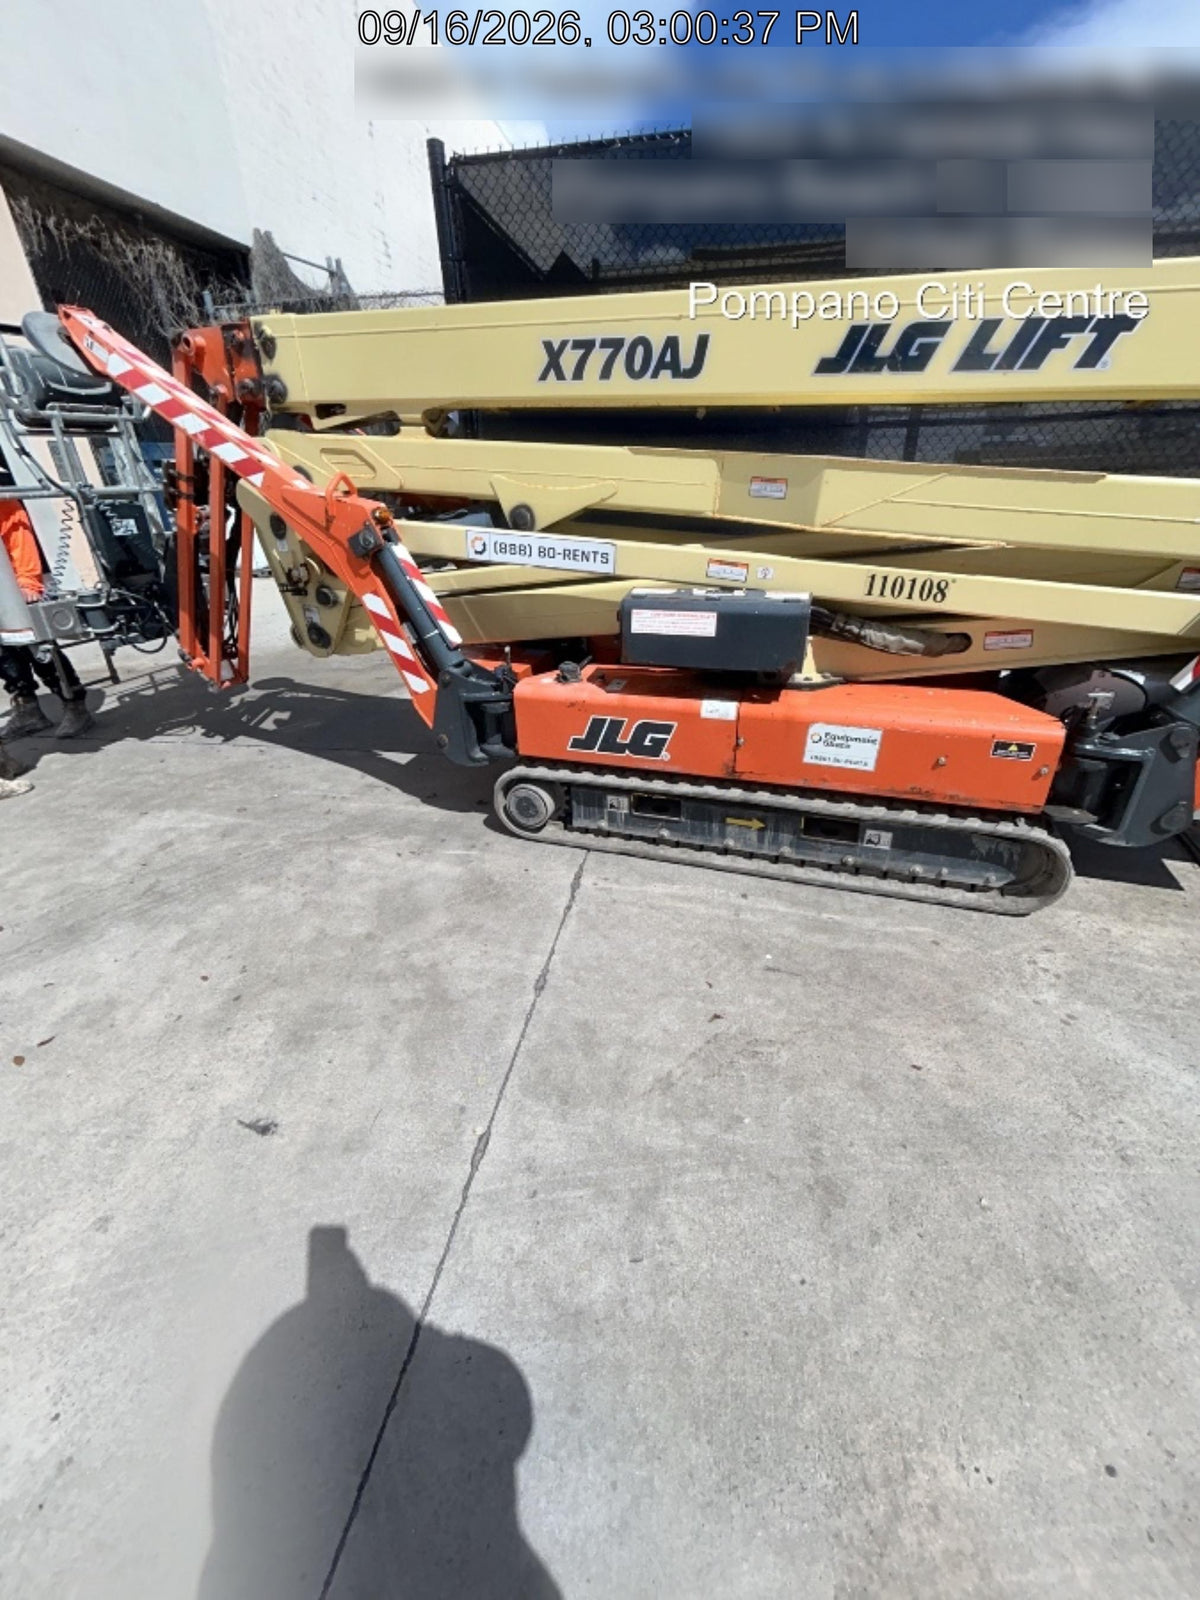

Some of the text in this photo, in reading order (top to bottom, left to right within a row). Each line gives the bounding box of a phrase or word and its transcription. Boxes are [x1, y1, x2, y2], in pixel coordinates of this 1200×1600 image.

[537, 333, 711, 382] X770AJ
[814, 313, 1141, 373] JLG LIFT
[493, 540, 533, 557] (888)
[864, 573, 949, 603] 110108
[567, 715, 678, 760] JLG
